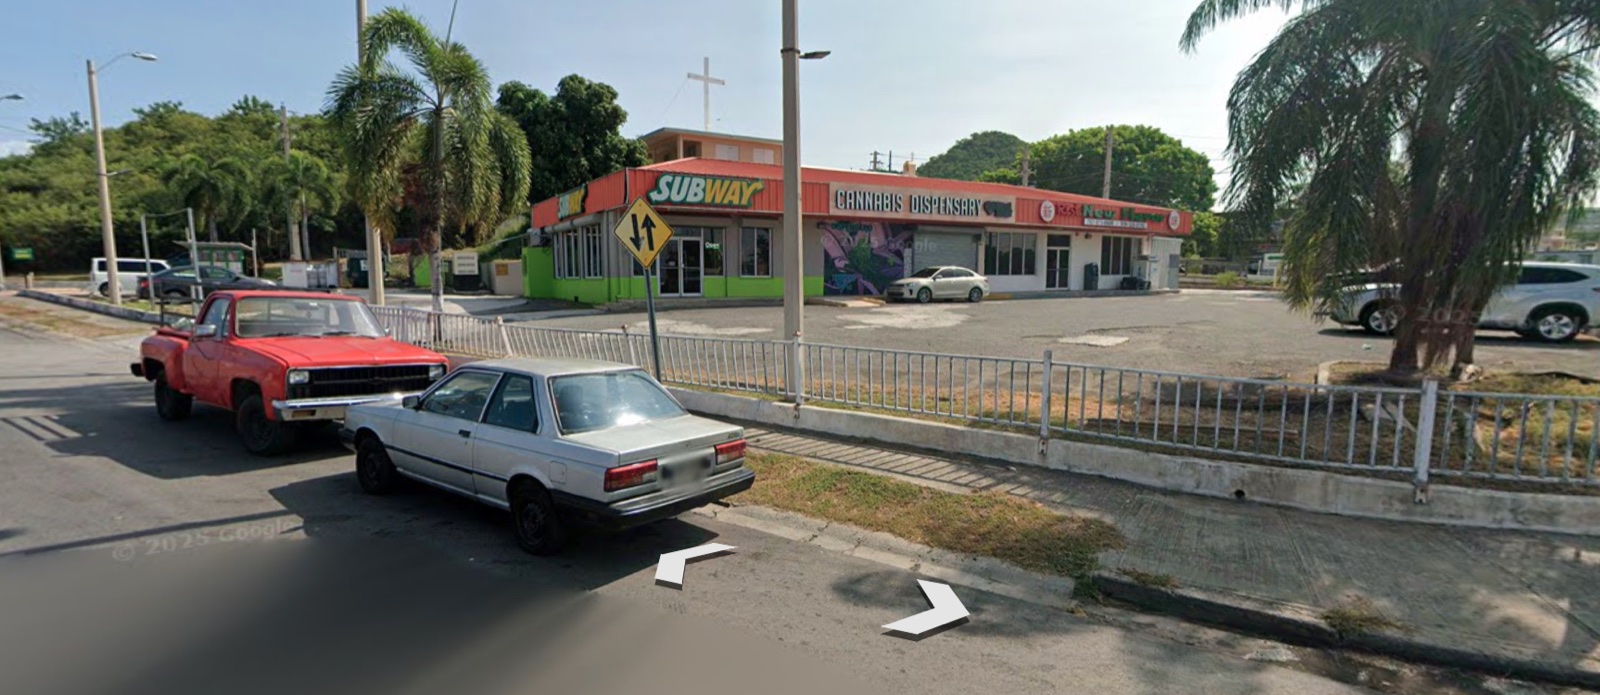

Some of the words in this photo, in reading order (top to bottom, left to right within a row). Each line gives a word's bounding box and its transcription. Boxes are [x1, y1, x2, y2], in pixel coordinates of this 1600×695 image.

[650, 174, 764, 206] SUBWAY
[836, 189, 903, 212] CANNABIS
[910, 194, 983, 216] DISPENSARY
[705, 241, 720, 250] Open
